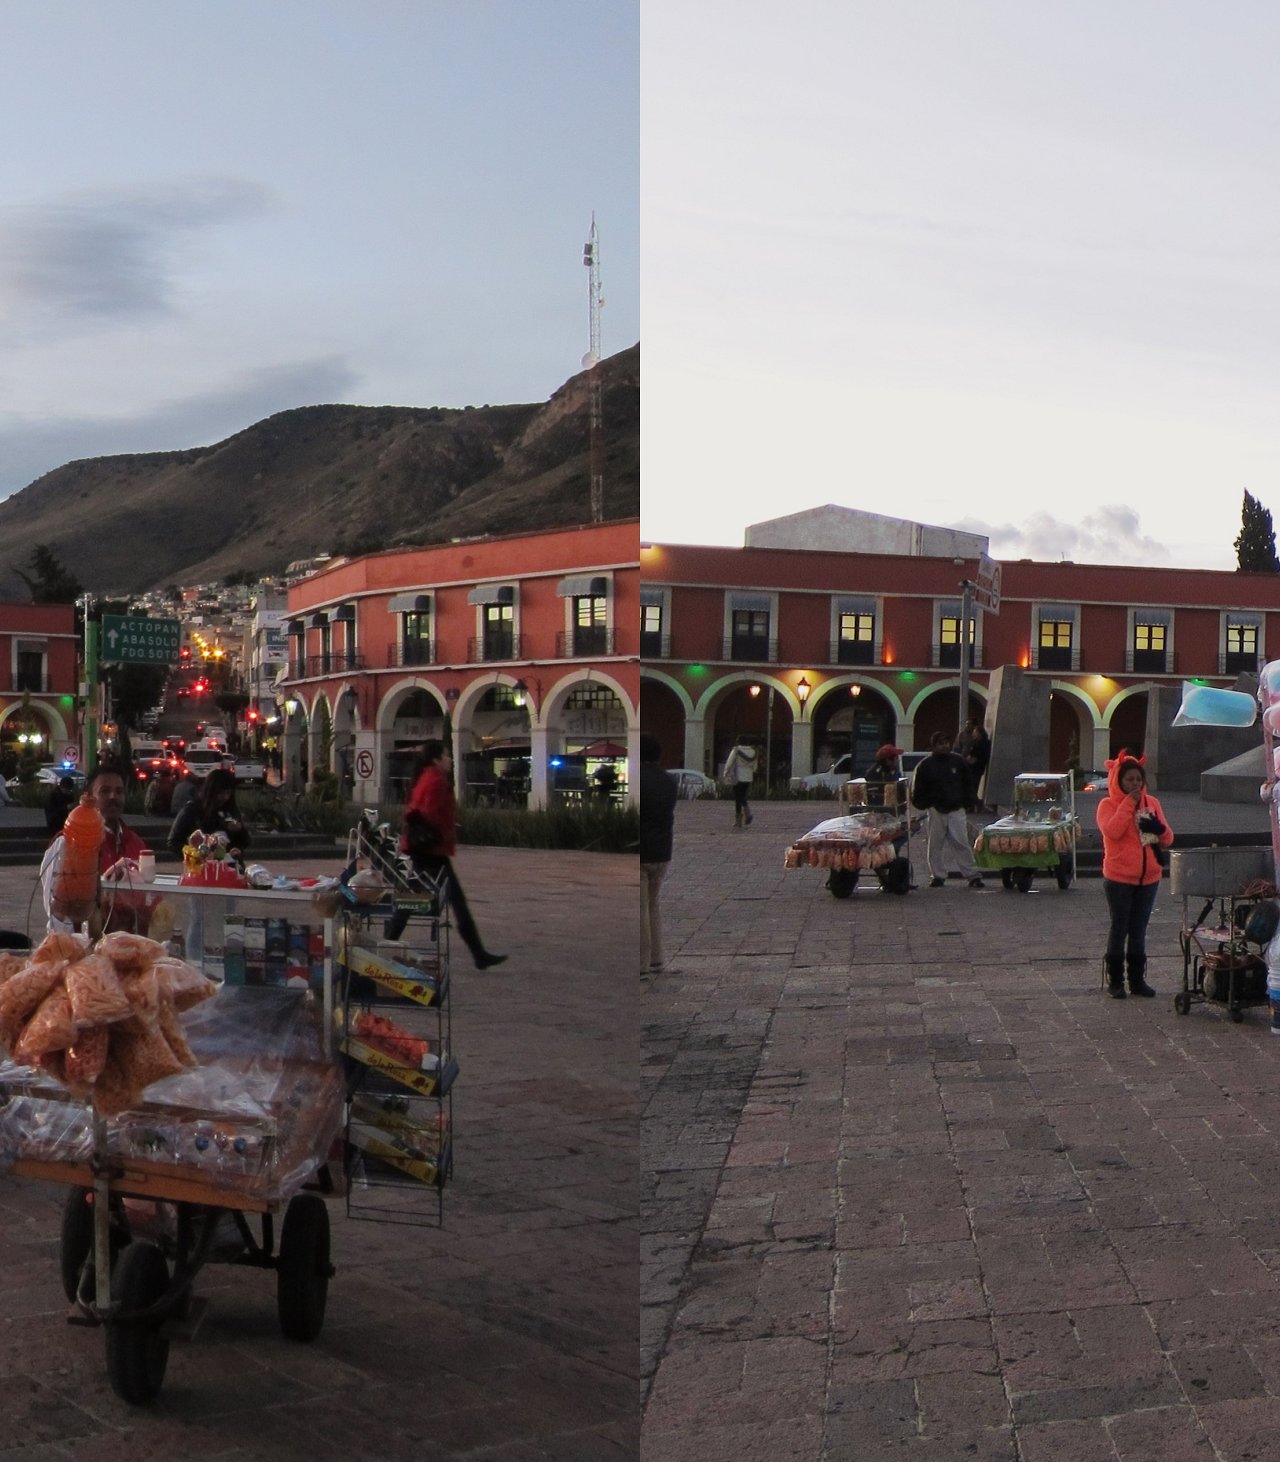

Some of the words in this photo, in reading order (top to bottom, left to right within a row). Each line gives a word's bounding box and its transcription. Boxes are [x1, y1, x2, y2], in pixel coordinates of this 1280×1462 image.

[119, 621, 178, 634] ACTOPAN
[122, 635, 178, 647] ABASOLO
[148, 649, 179, 660] SOTO
[384, 972, 404, 990] Rosa
